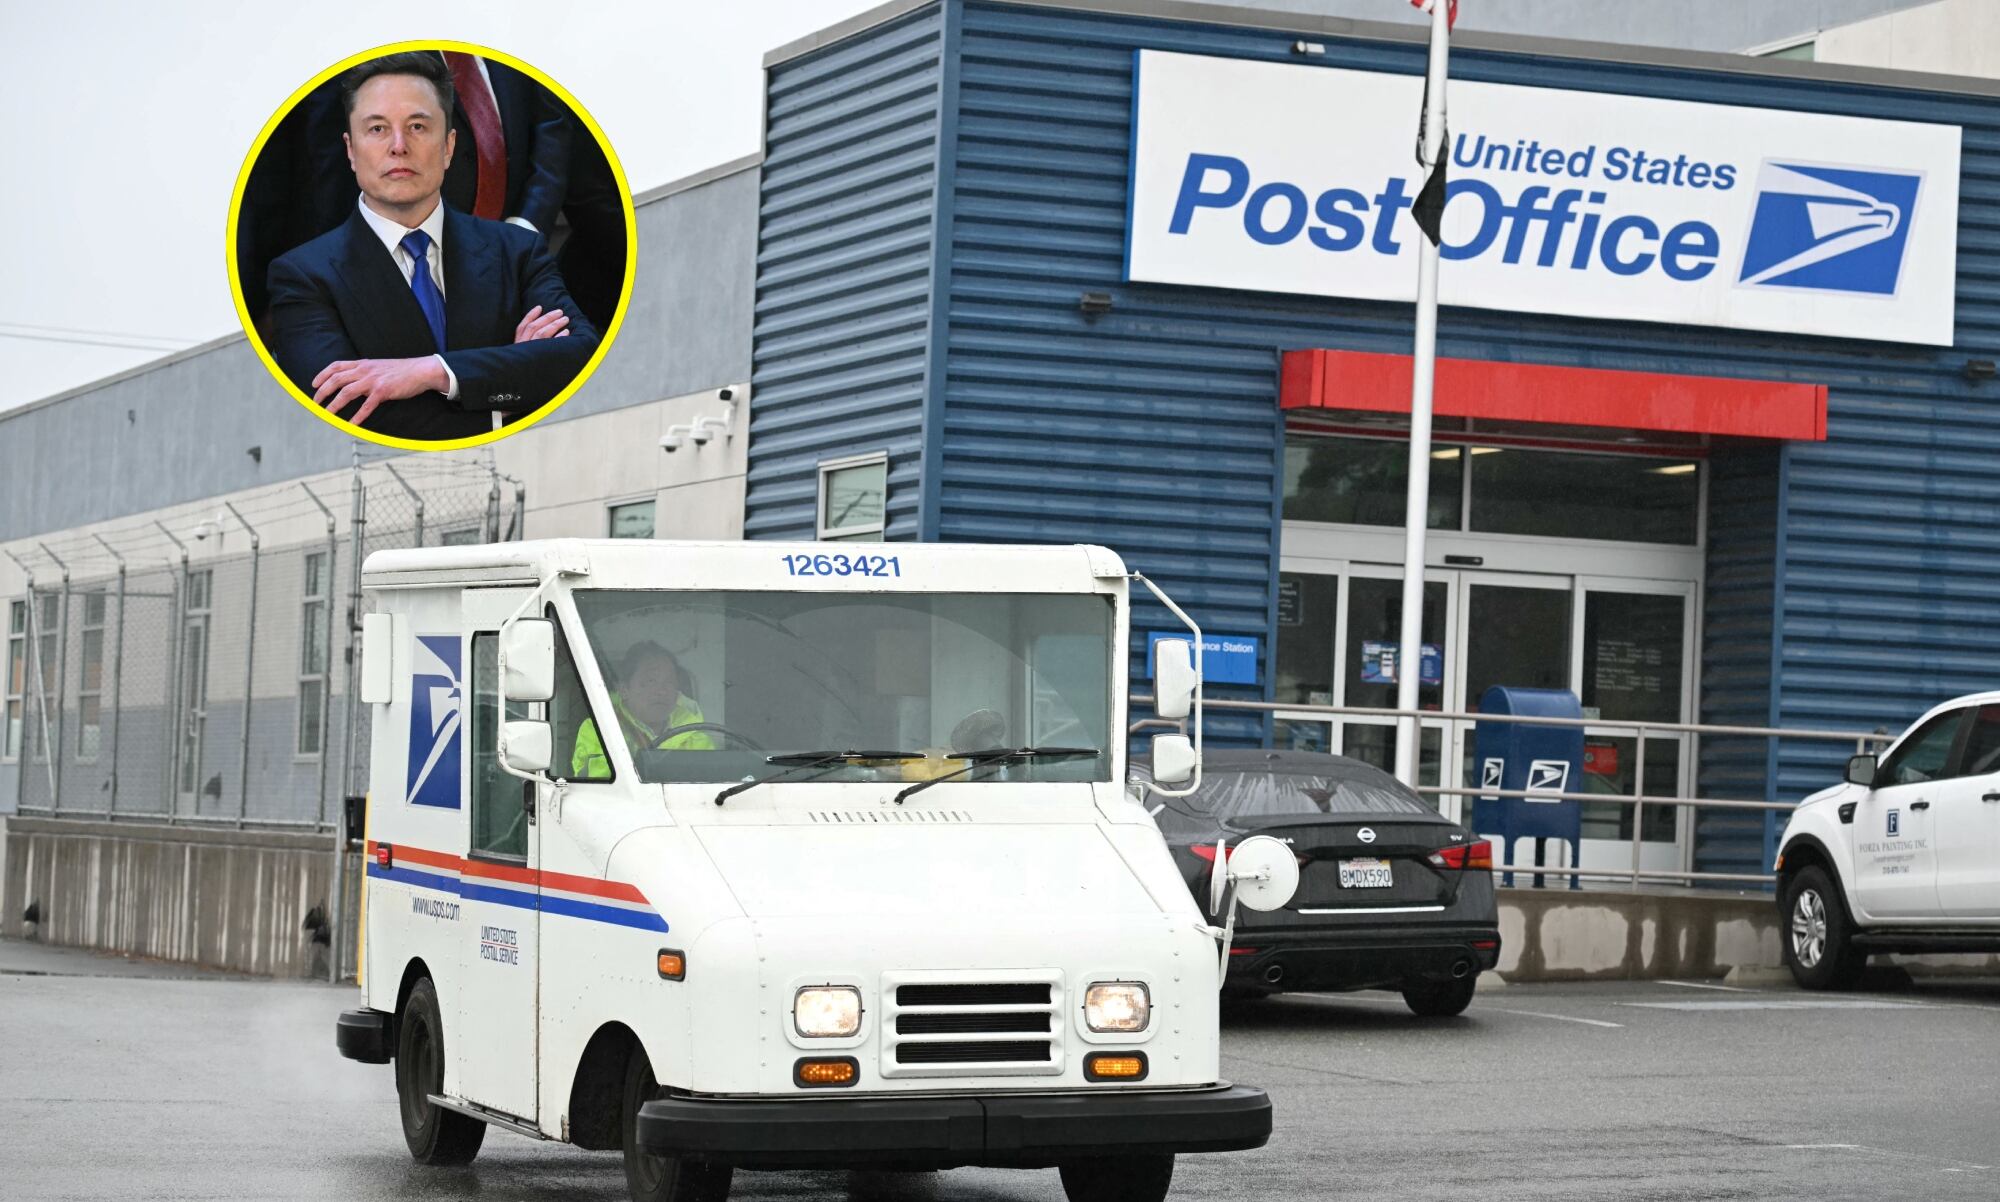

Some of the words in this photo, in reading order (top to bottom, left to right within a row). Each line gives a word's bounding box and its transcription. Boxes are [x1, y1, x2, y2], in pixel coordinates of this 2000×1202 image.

[1453, 133, 1596, 178] United
[1602, 146, 1737, 190] States
[1168, 152, 1413, 256] Post
[1438, 178, 1720, 281] Office
[781, 554, 901, 577] 1263421
[1222, 641, 1254, 653] Station
[1882, 839, 1913, 852] PAINTING
[1341, 868, 1390, 884] 8MDX590
[412, 896, 460, 923] www.usps.com
[481, 925, 500, 943] UNITED
[500, 928, 517, 946] STATES
[480, 944, 498, 962] POSTAL
[499, 947, 519, 966] SERVICE
